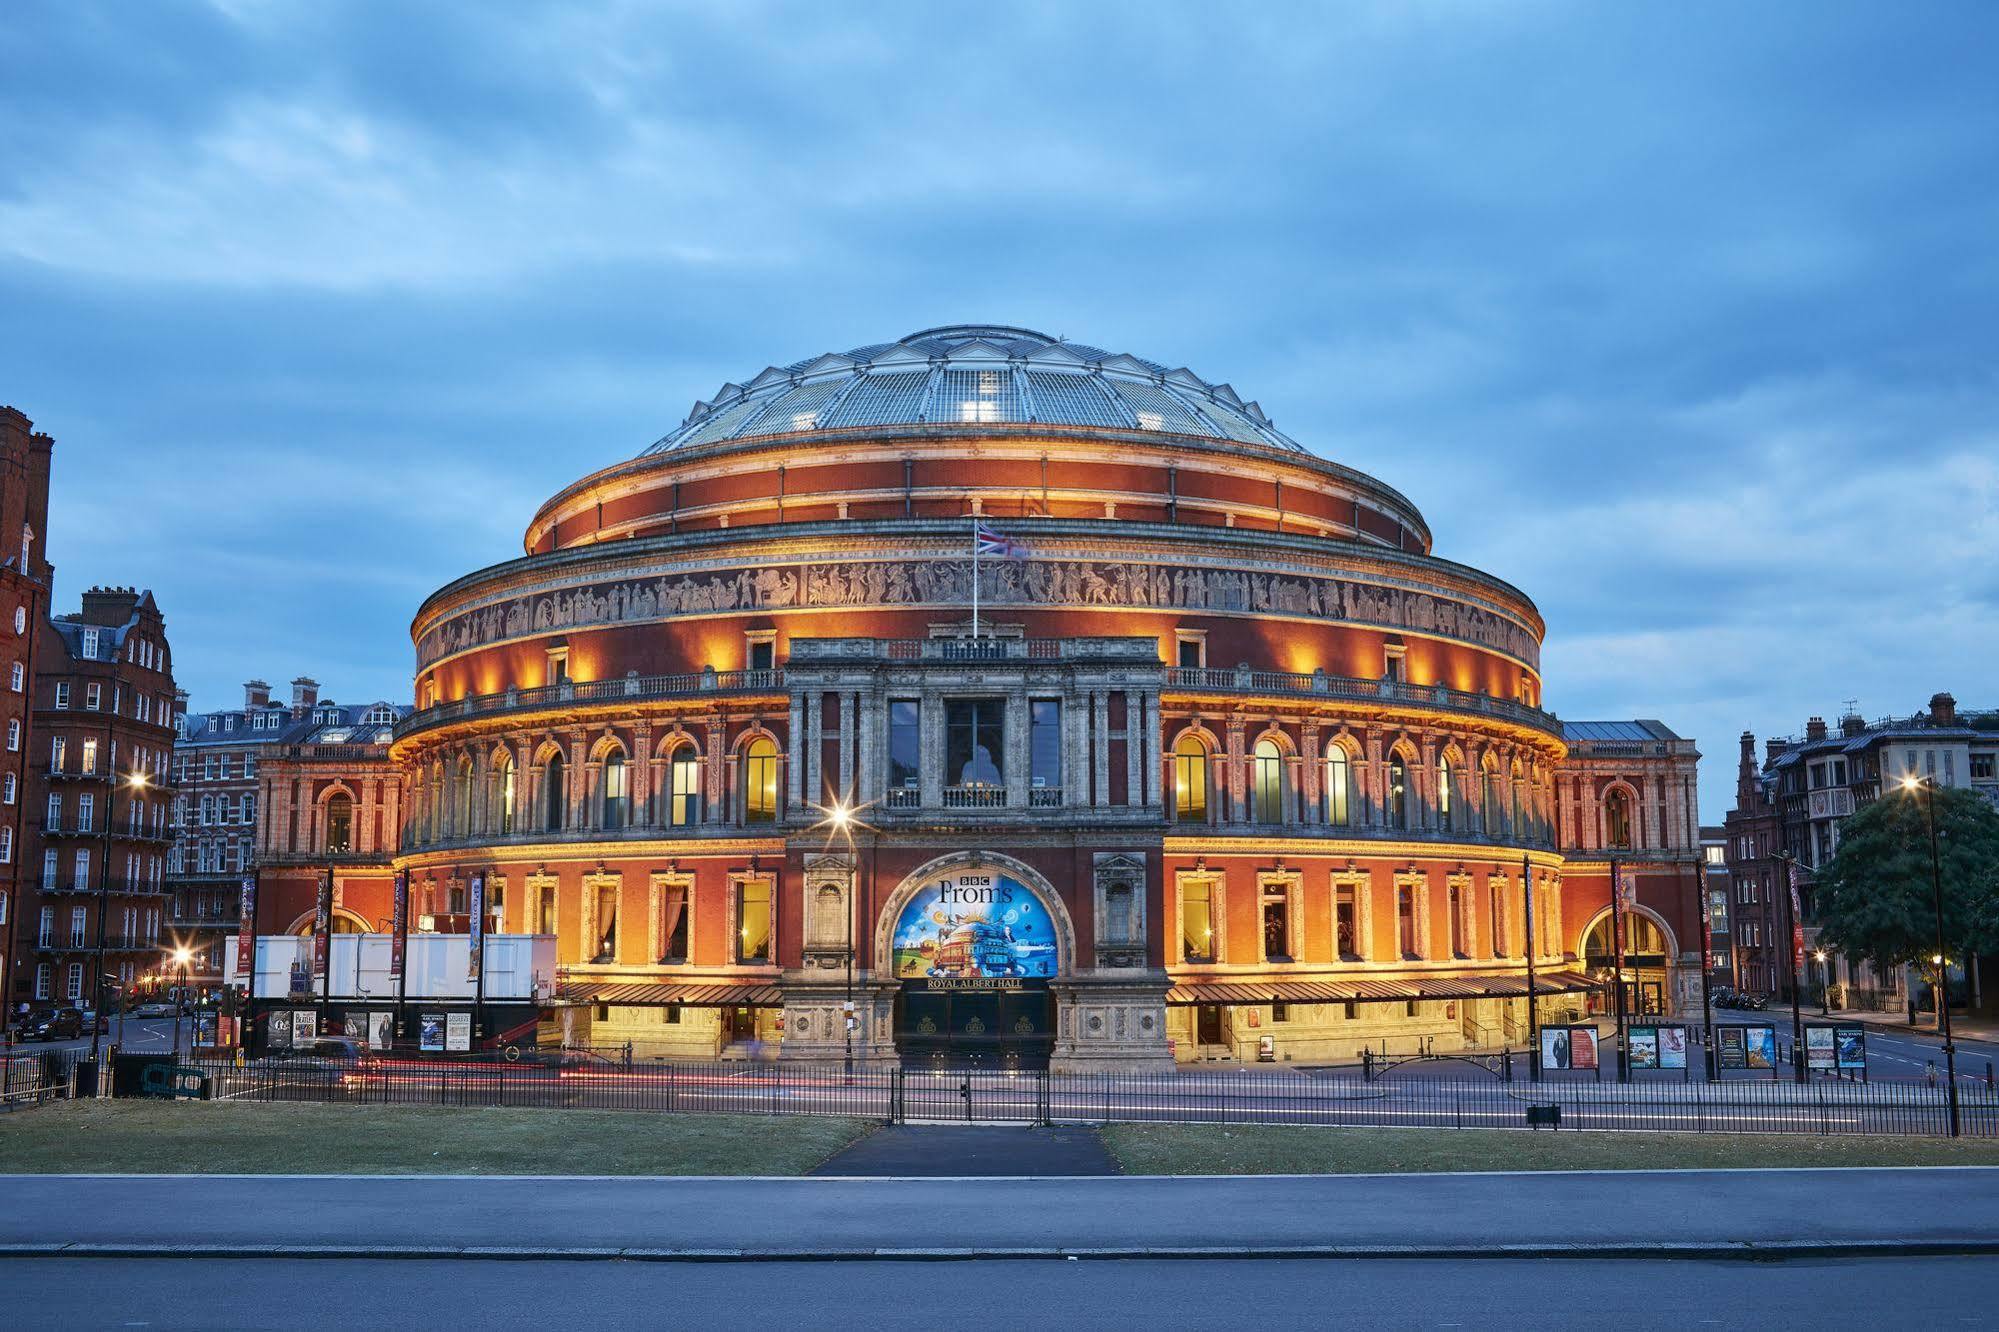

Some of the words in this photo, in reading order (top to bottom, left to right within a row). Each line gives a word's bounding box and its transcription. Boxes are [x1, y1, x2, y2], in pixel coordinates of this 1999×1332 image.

[960, 877, 990, 885] BBC
[938, 880, 1012, 904] Proms
[1789, 870, 1798, 912] WELCOME
[927, 979, 958, 988] ROYAL
[960, 979, 996, 988] ALBERT
[997, 979, 1023, 988] HALL
